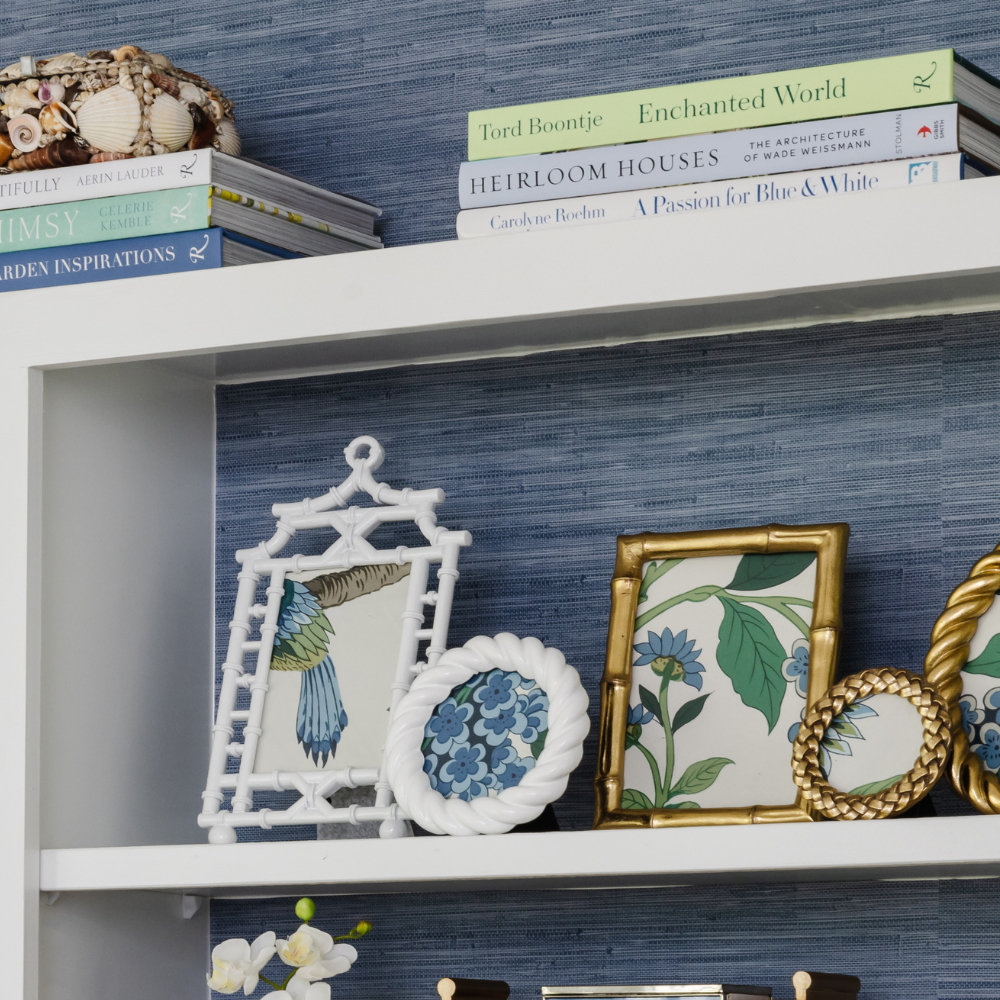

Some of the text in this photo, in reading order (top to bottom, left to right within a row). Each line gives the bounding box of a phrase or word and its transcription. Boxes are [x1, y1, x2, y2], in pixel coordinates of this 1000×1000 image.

[479, 77, 847, 141] Tord Boontje Enchanted World
[750, 128, 866, 150] THE ARCHITECTURE
[894, 113, 902, 155] STOLMAN
[743, 140, 871, 163] OF WADE WEISSMANN
[76, 172, 113, 187] AERIN
[117, 165, 164, 182] LAUDER
[470, 148, 719, 194] HEIRLOOM HOUSES
[99, 201, 154, 218] CELERIE
[490, 171, 879, 231] Carolyne Roehm A Passion for Blue & White
[101, 215, 152, 232] KEMBLE
[54, 246, 176, 275] INSPIRATIONS
